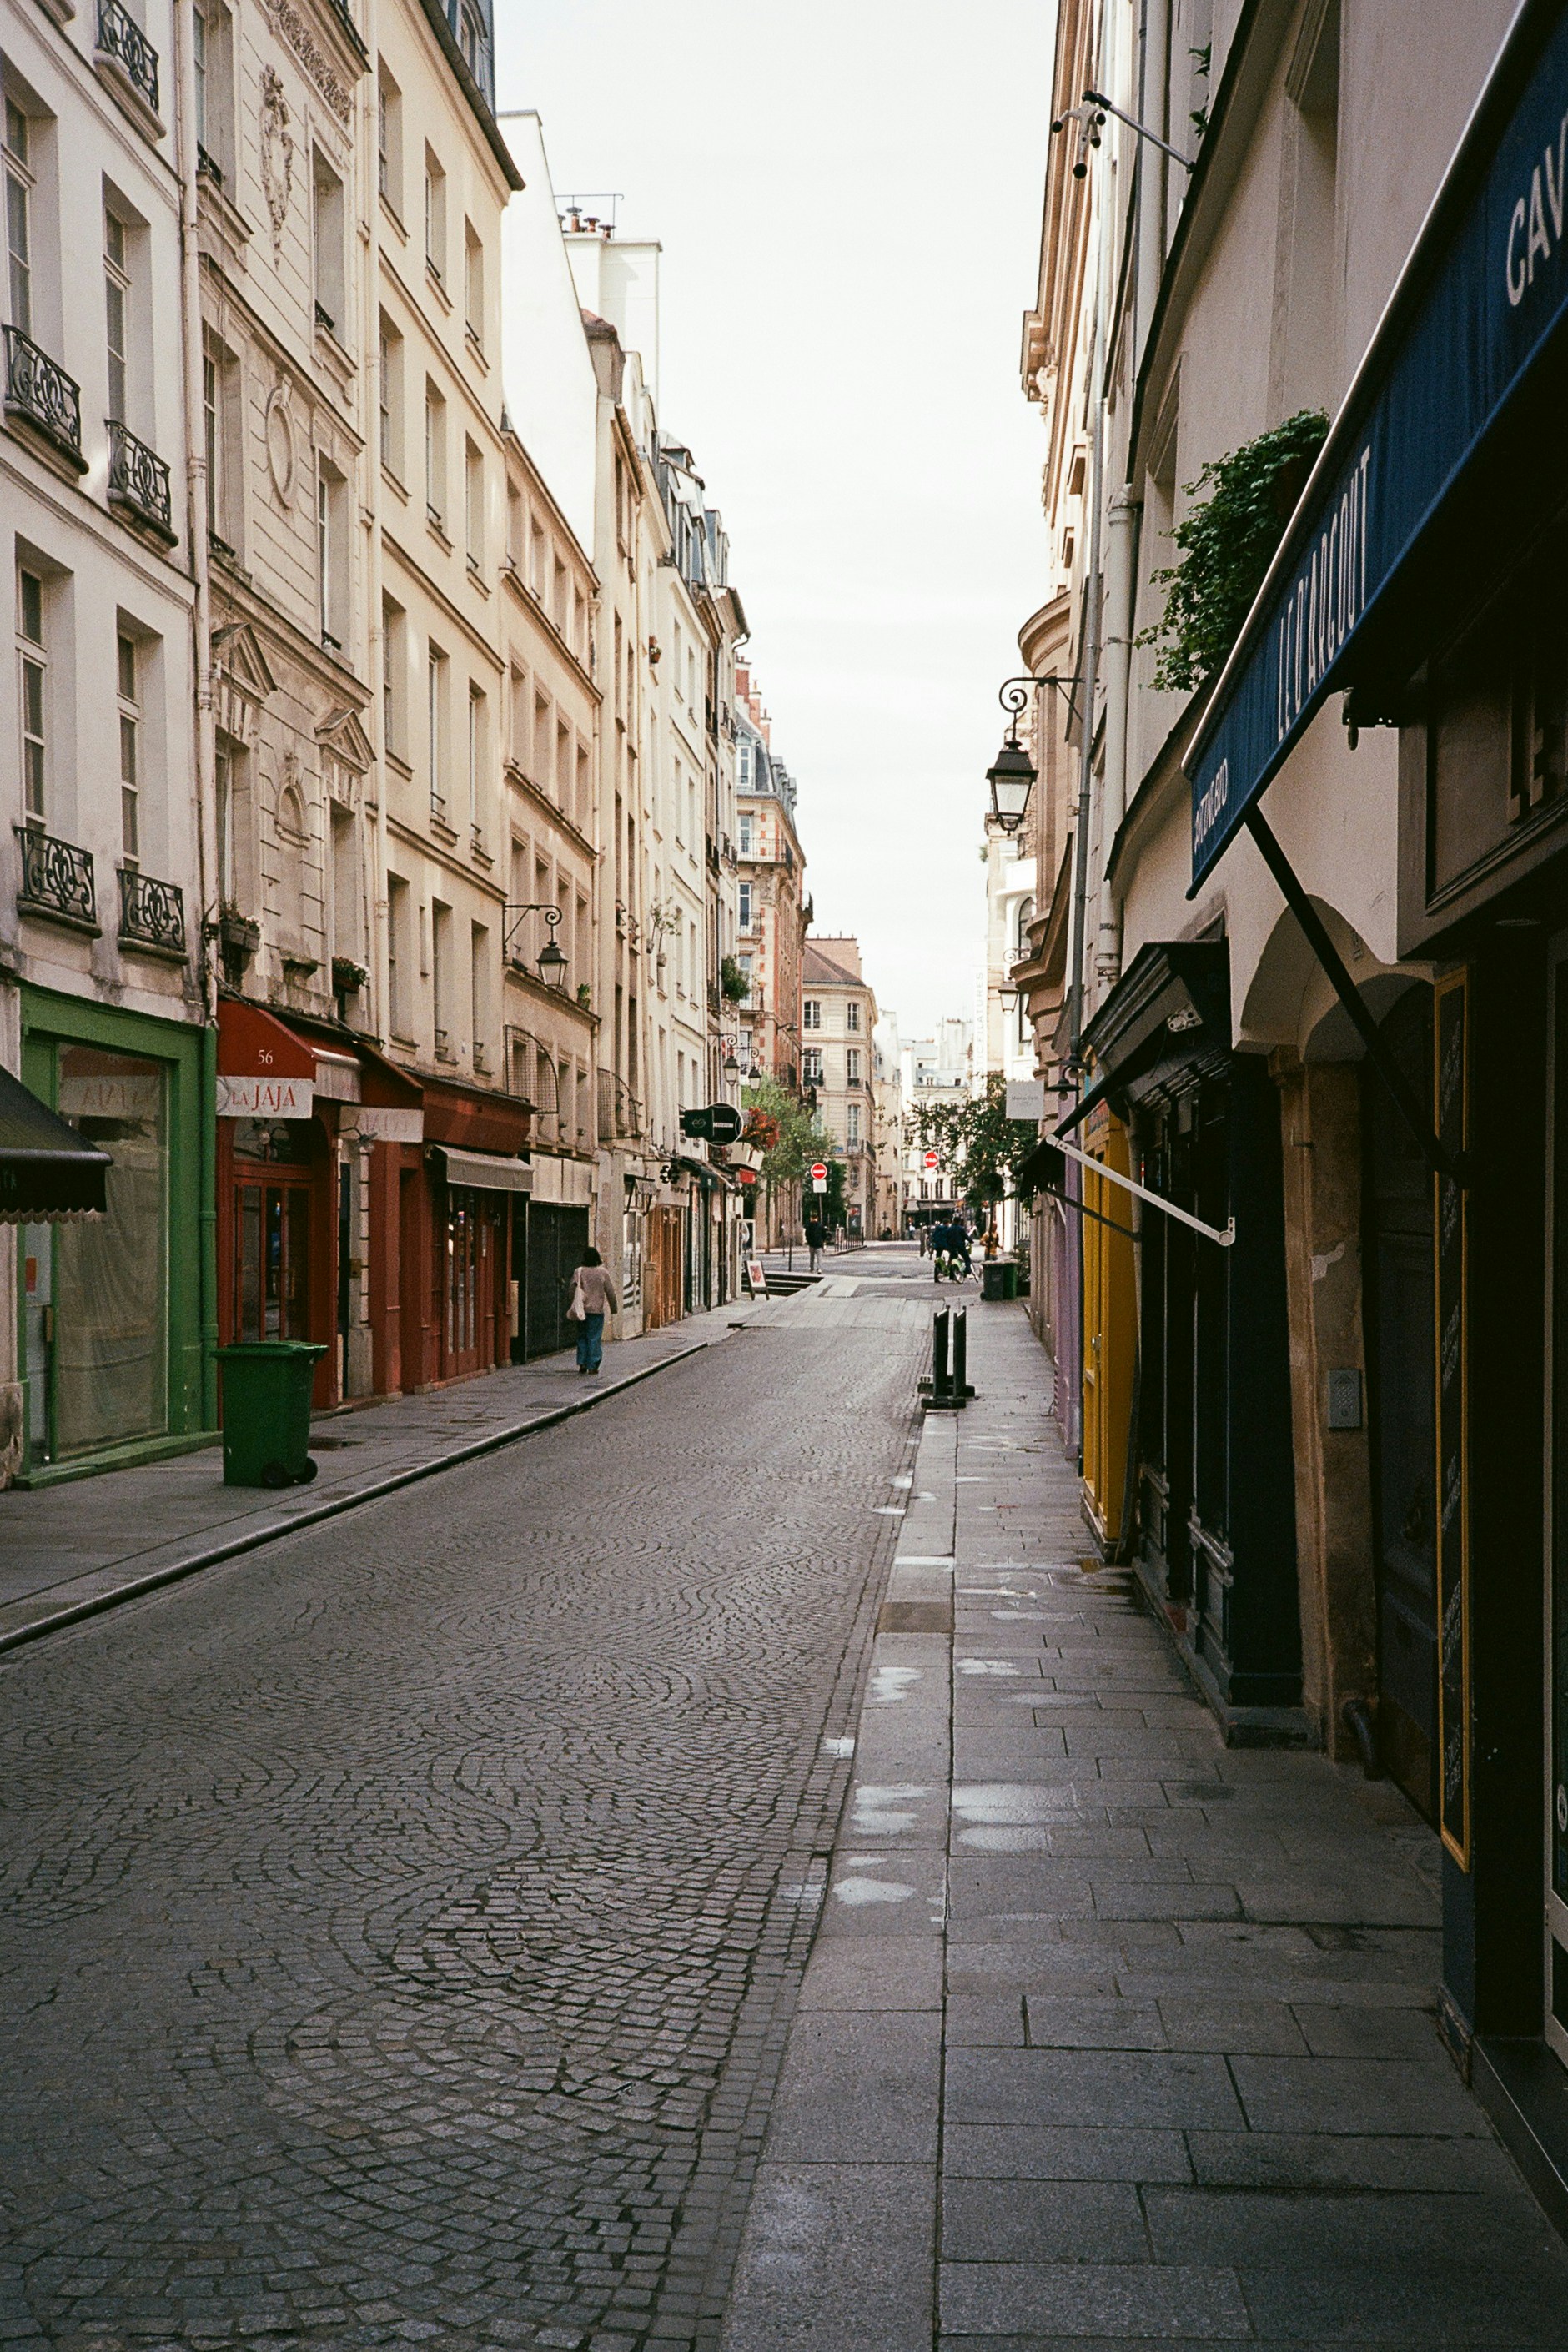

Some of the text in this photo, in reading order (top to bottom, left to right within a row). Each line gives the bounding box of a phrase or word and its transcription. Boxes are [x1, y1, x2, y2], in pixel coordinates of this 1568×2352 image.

[1294, 443, 1371, 716] D'ARGOUT
[258, 1049, 274, 1064] 56
[232, 1084, 296, 1112] LA JAJA
